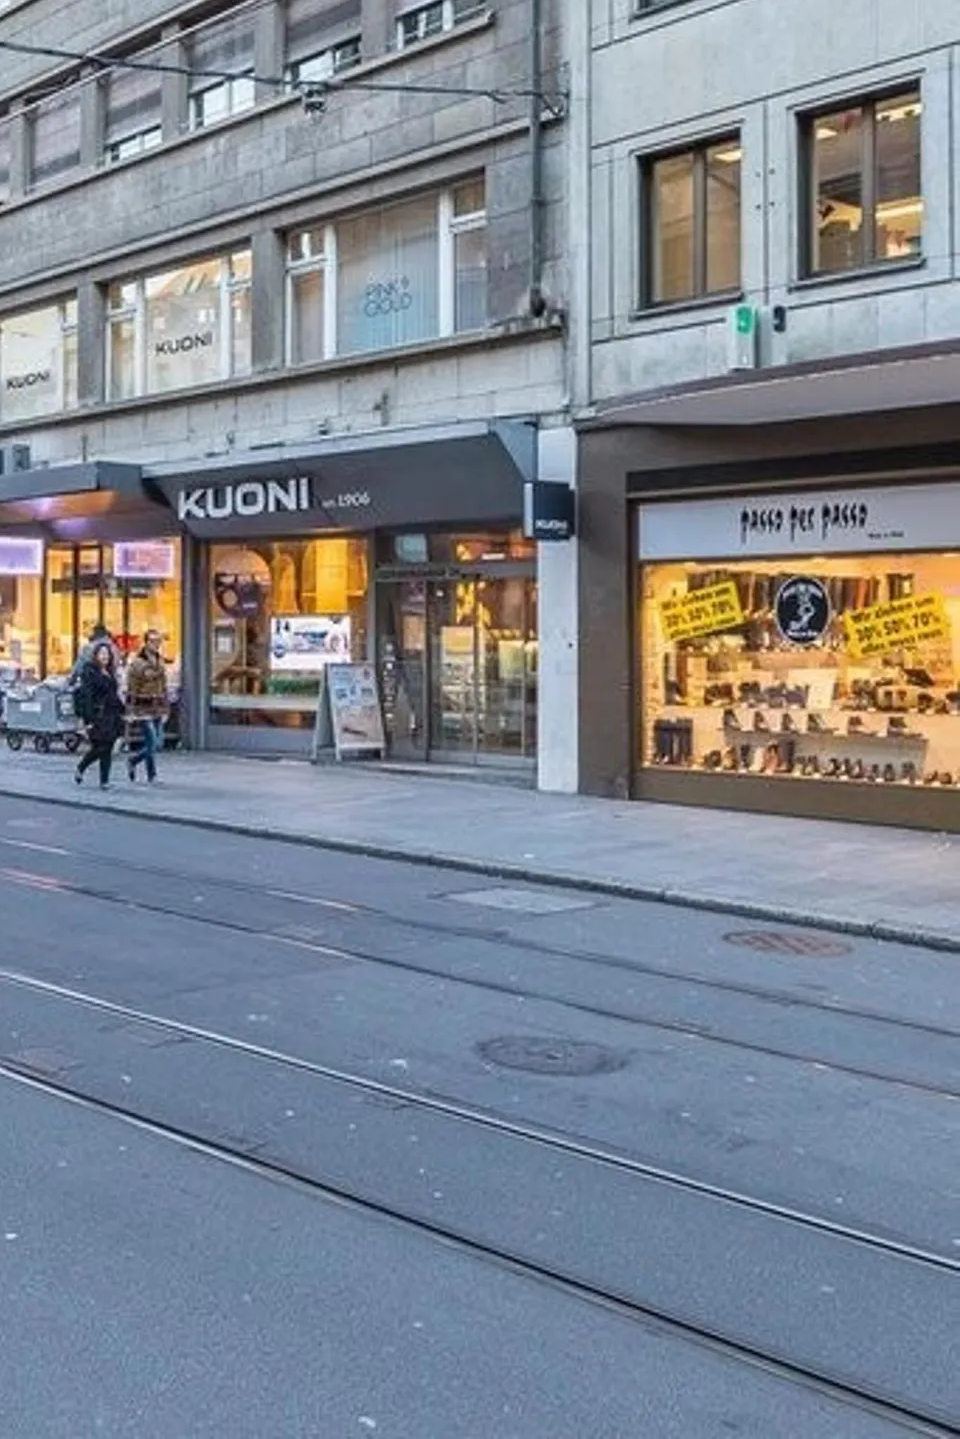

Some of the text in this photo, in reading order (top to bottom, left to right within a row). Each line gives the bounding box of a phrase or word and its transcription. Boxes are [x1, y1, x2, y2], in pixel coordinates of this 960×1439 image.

[155, 331, 214, 357] KUONI
[6, 369, 52, 390] KUONI
[178, 477, 371, 521] KUONI 1906
